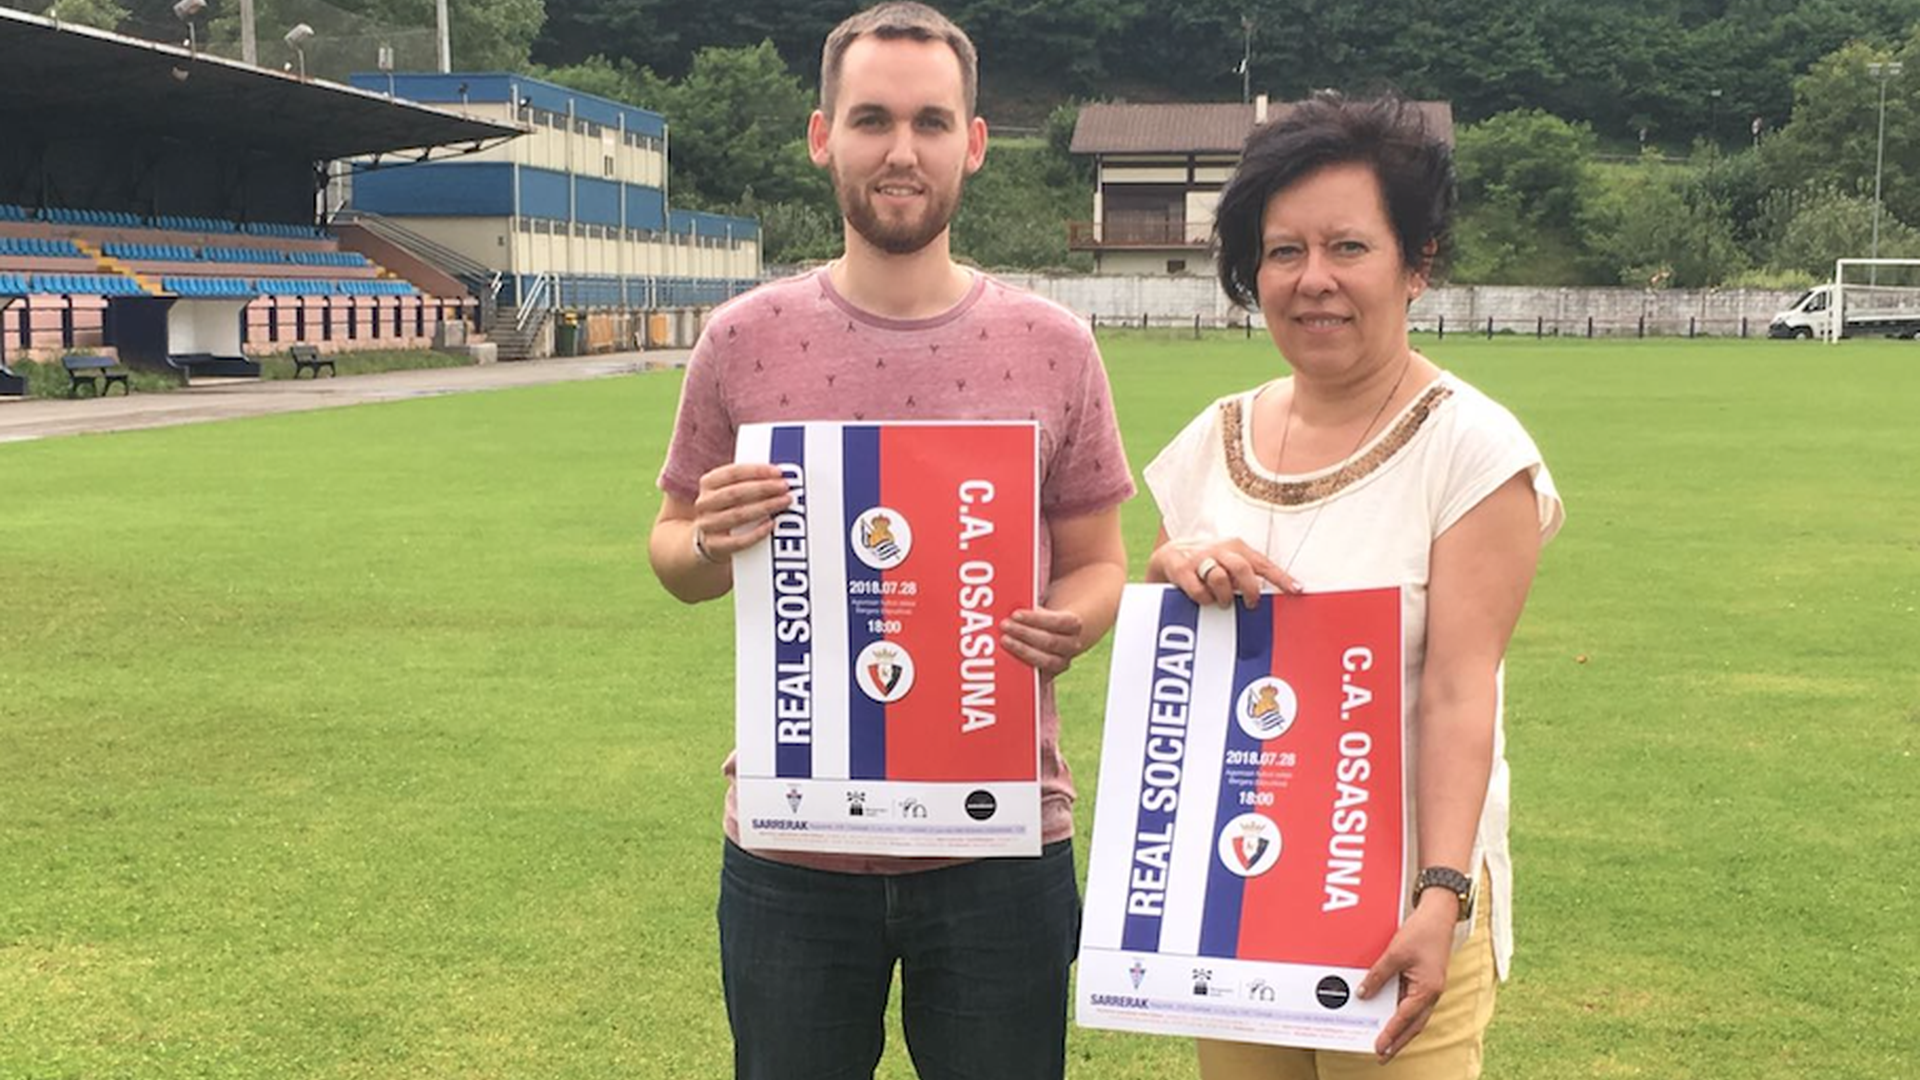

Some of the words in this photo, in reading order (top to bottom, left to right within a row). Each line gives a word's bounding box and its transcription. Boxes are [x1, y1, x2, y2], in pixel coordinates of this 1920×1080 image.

[958, 479, 995, 551] C.A.
[849, 580, 918, 595] 2018.07.28
[867, 620, 902, 633] 18:00
[958, 561, 996, 733] OSASUNA
[777, 654, 811, 745] REAL
[1141, 624, 1195, 813] SOCIEDAD
[1341, 646, 1373, 720] C.A.
[1225, 750, 1296, 767] 2018.07.28
[752, 818, 809, 831] SARRERAK
[1239, 791, 1274, 806] 18:00
[1322, 731, 1372, 912] OSASUNA
[1127, 823, 1173, 918] REAL
[1090, 993, 1150, 1010] SARRERAK
